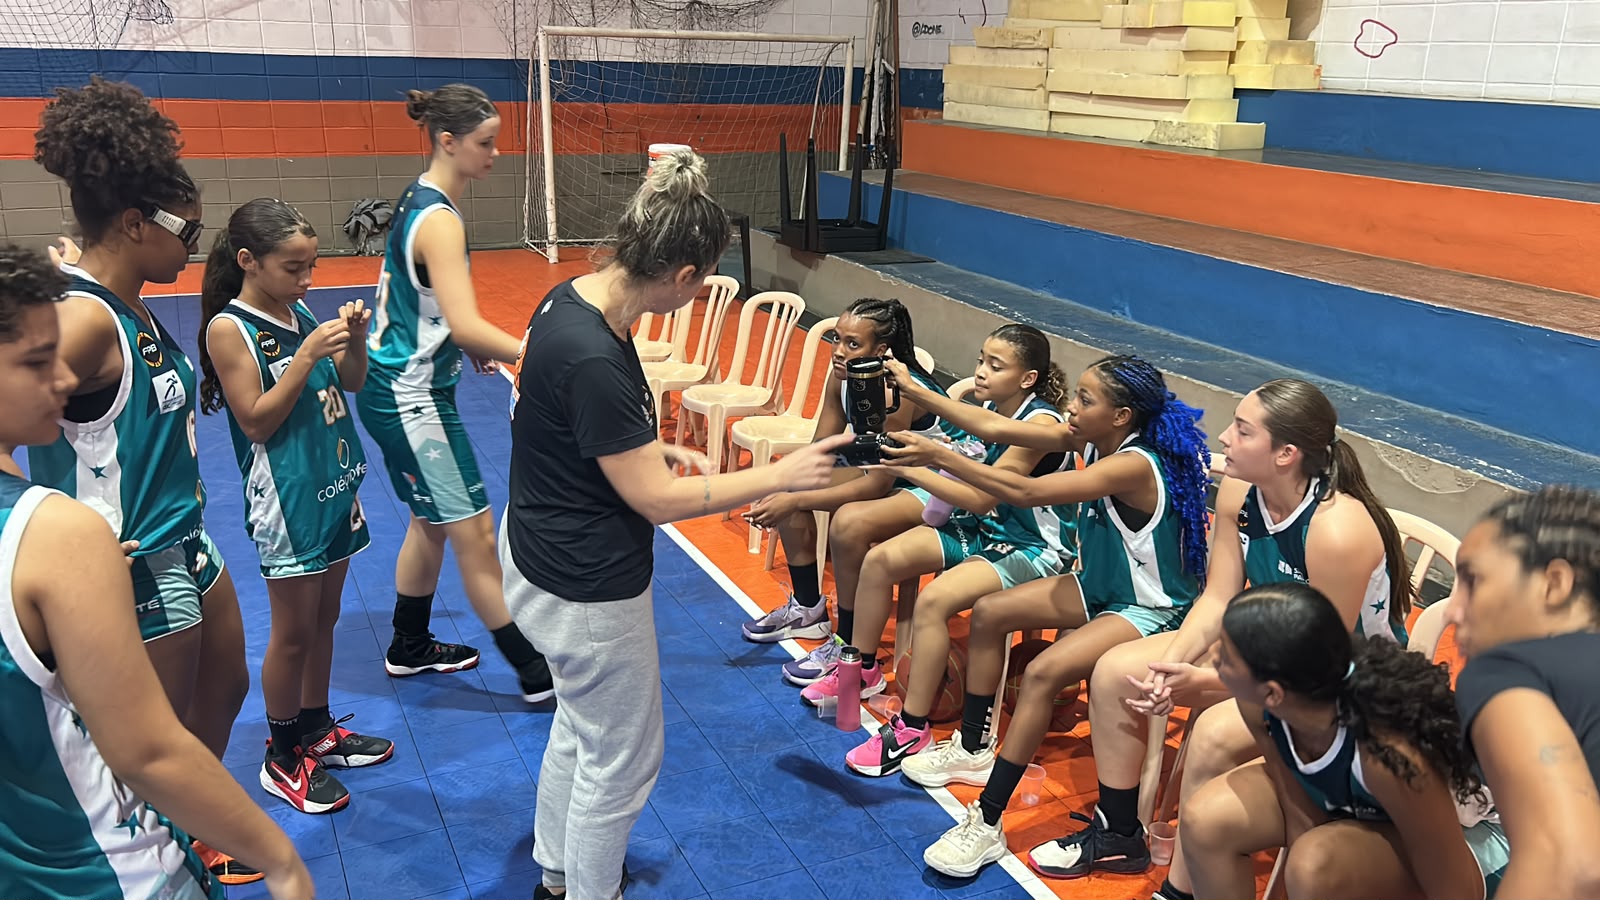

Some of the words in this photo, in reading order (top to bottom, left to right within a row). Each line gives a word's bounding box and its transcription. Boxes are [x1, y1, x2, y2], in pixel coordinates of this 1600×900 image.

[142, 343, 158, 356] FPB
[317, 384, 347, 425] 20
[313, 738, 337, 754] NIKE
